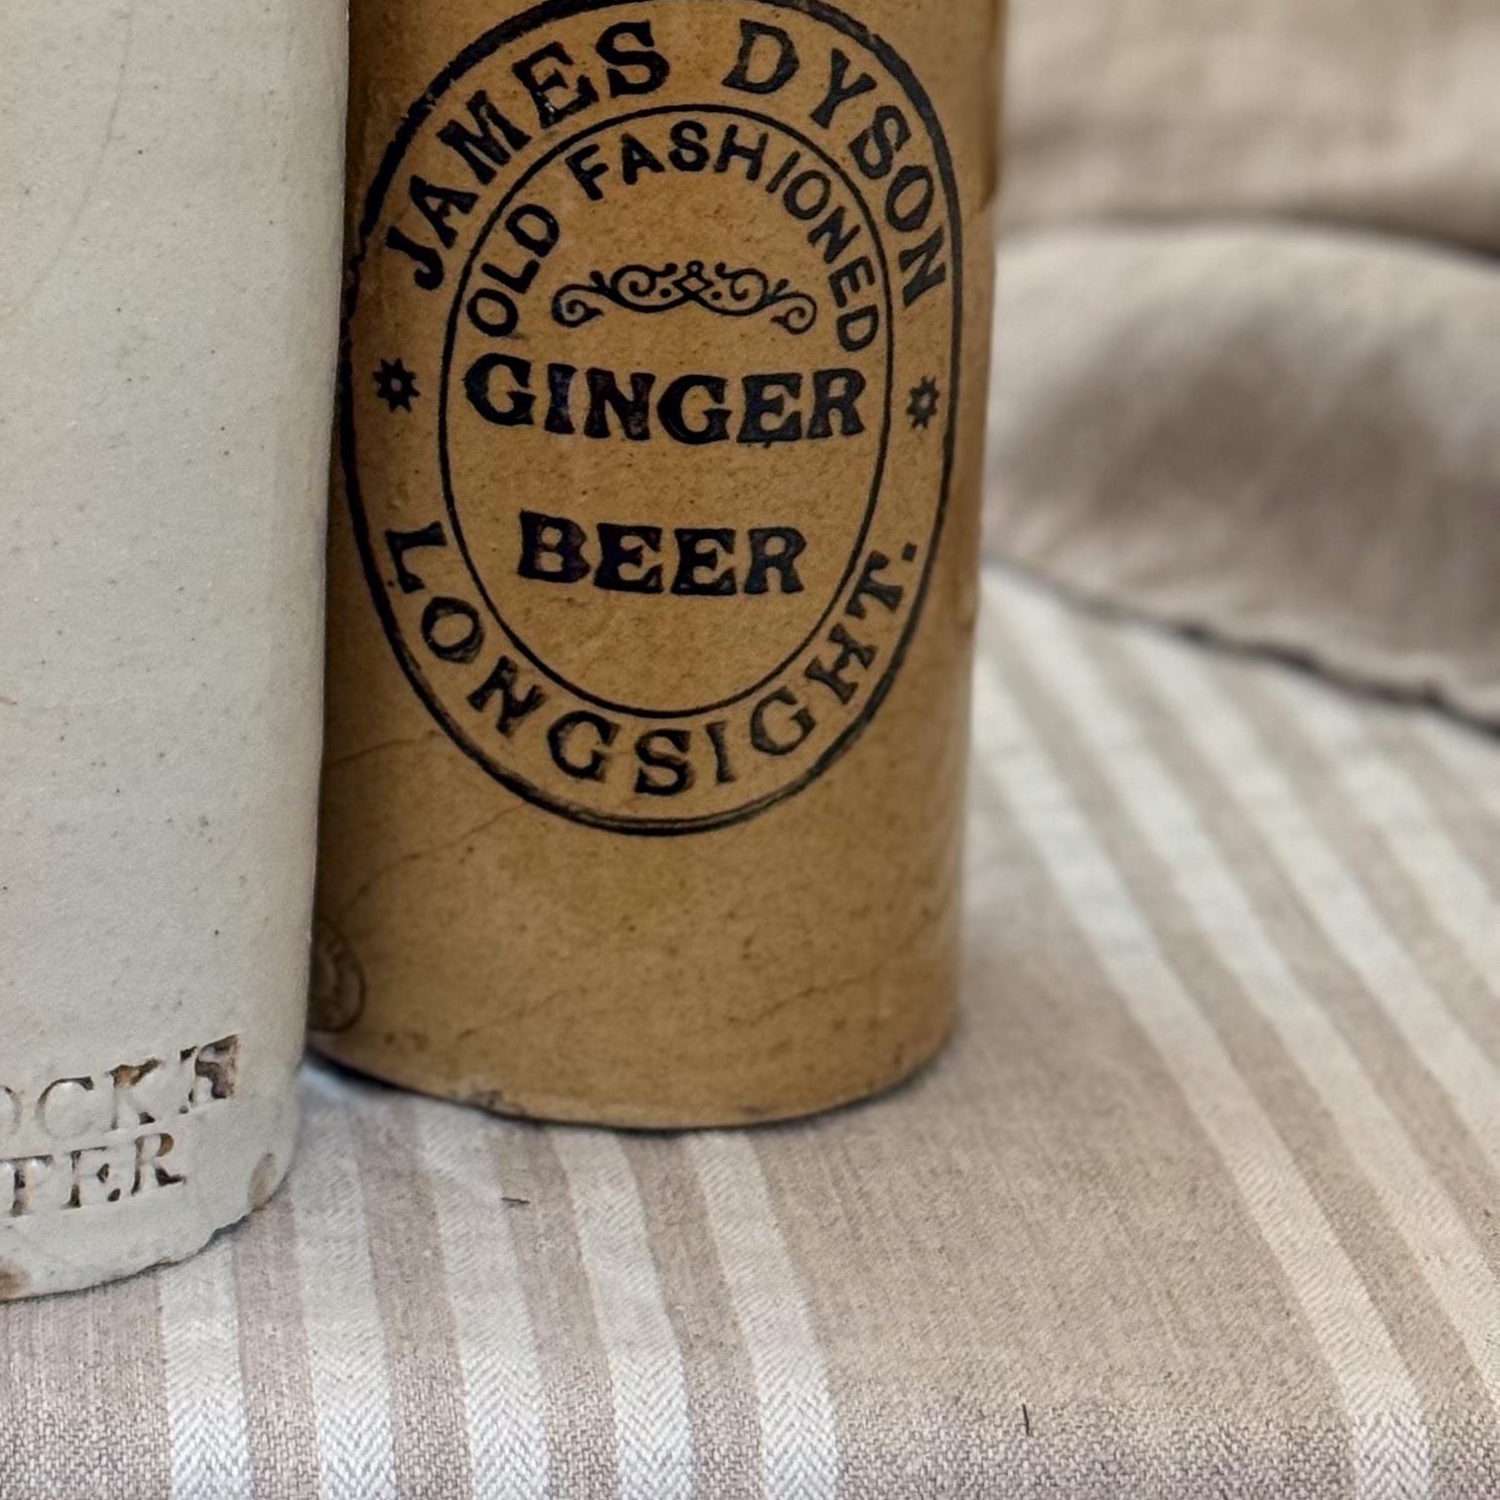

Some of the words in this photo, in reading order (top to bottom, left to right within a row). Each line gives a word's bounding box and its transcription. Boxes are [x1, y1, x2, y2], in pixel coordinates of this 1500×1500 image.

[386, 20, 672, 292] JAMES
[721, 18, 948, 308] DYSON
[465, 202, 560, 338] OLD
[569, 119, 880, 352] FASHIONED
[463, 352, 867, 445] GINGER
[516, 509, 807, 598] BEER
